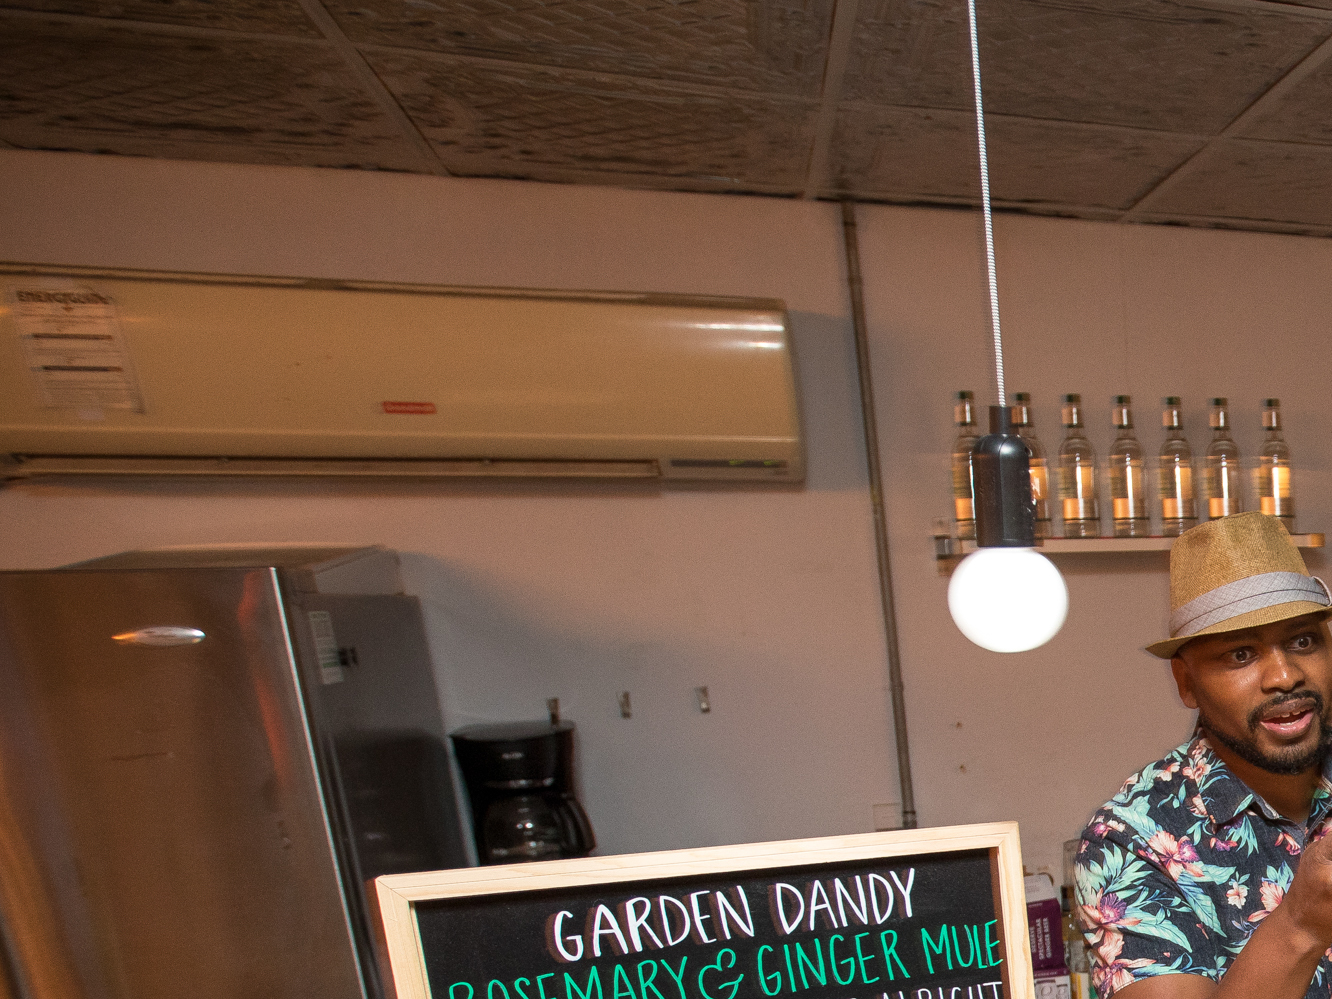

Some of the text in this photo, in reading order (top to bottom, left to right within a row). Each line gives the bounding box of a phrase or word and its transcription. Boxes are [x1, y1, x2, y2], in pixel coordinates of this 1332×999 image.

[554, 868, 915, 961] GARDEN DANDY
[757, 930, 910, 996] GINGER
[921, 919, 1003, 974] MULE
